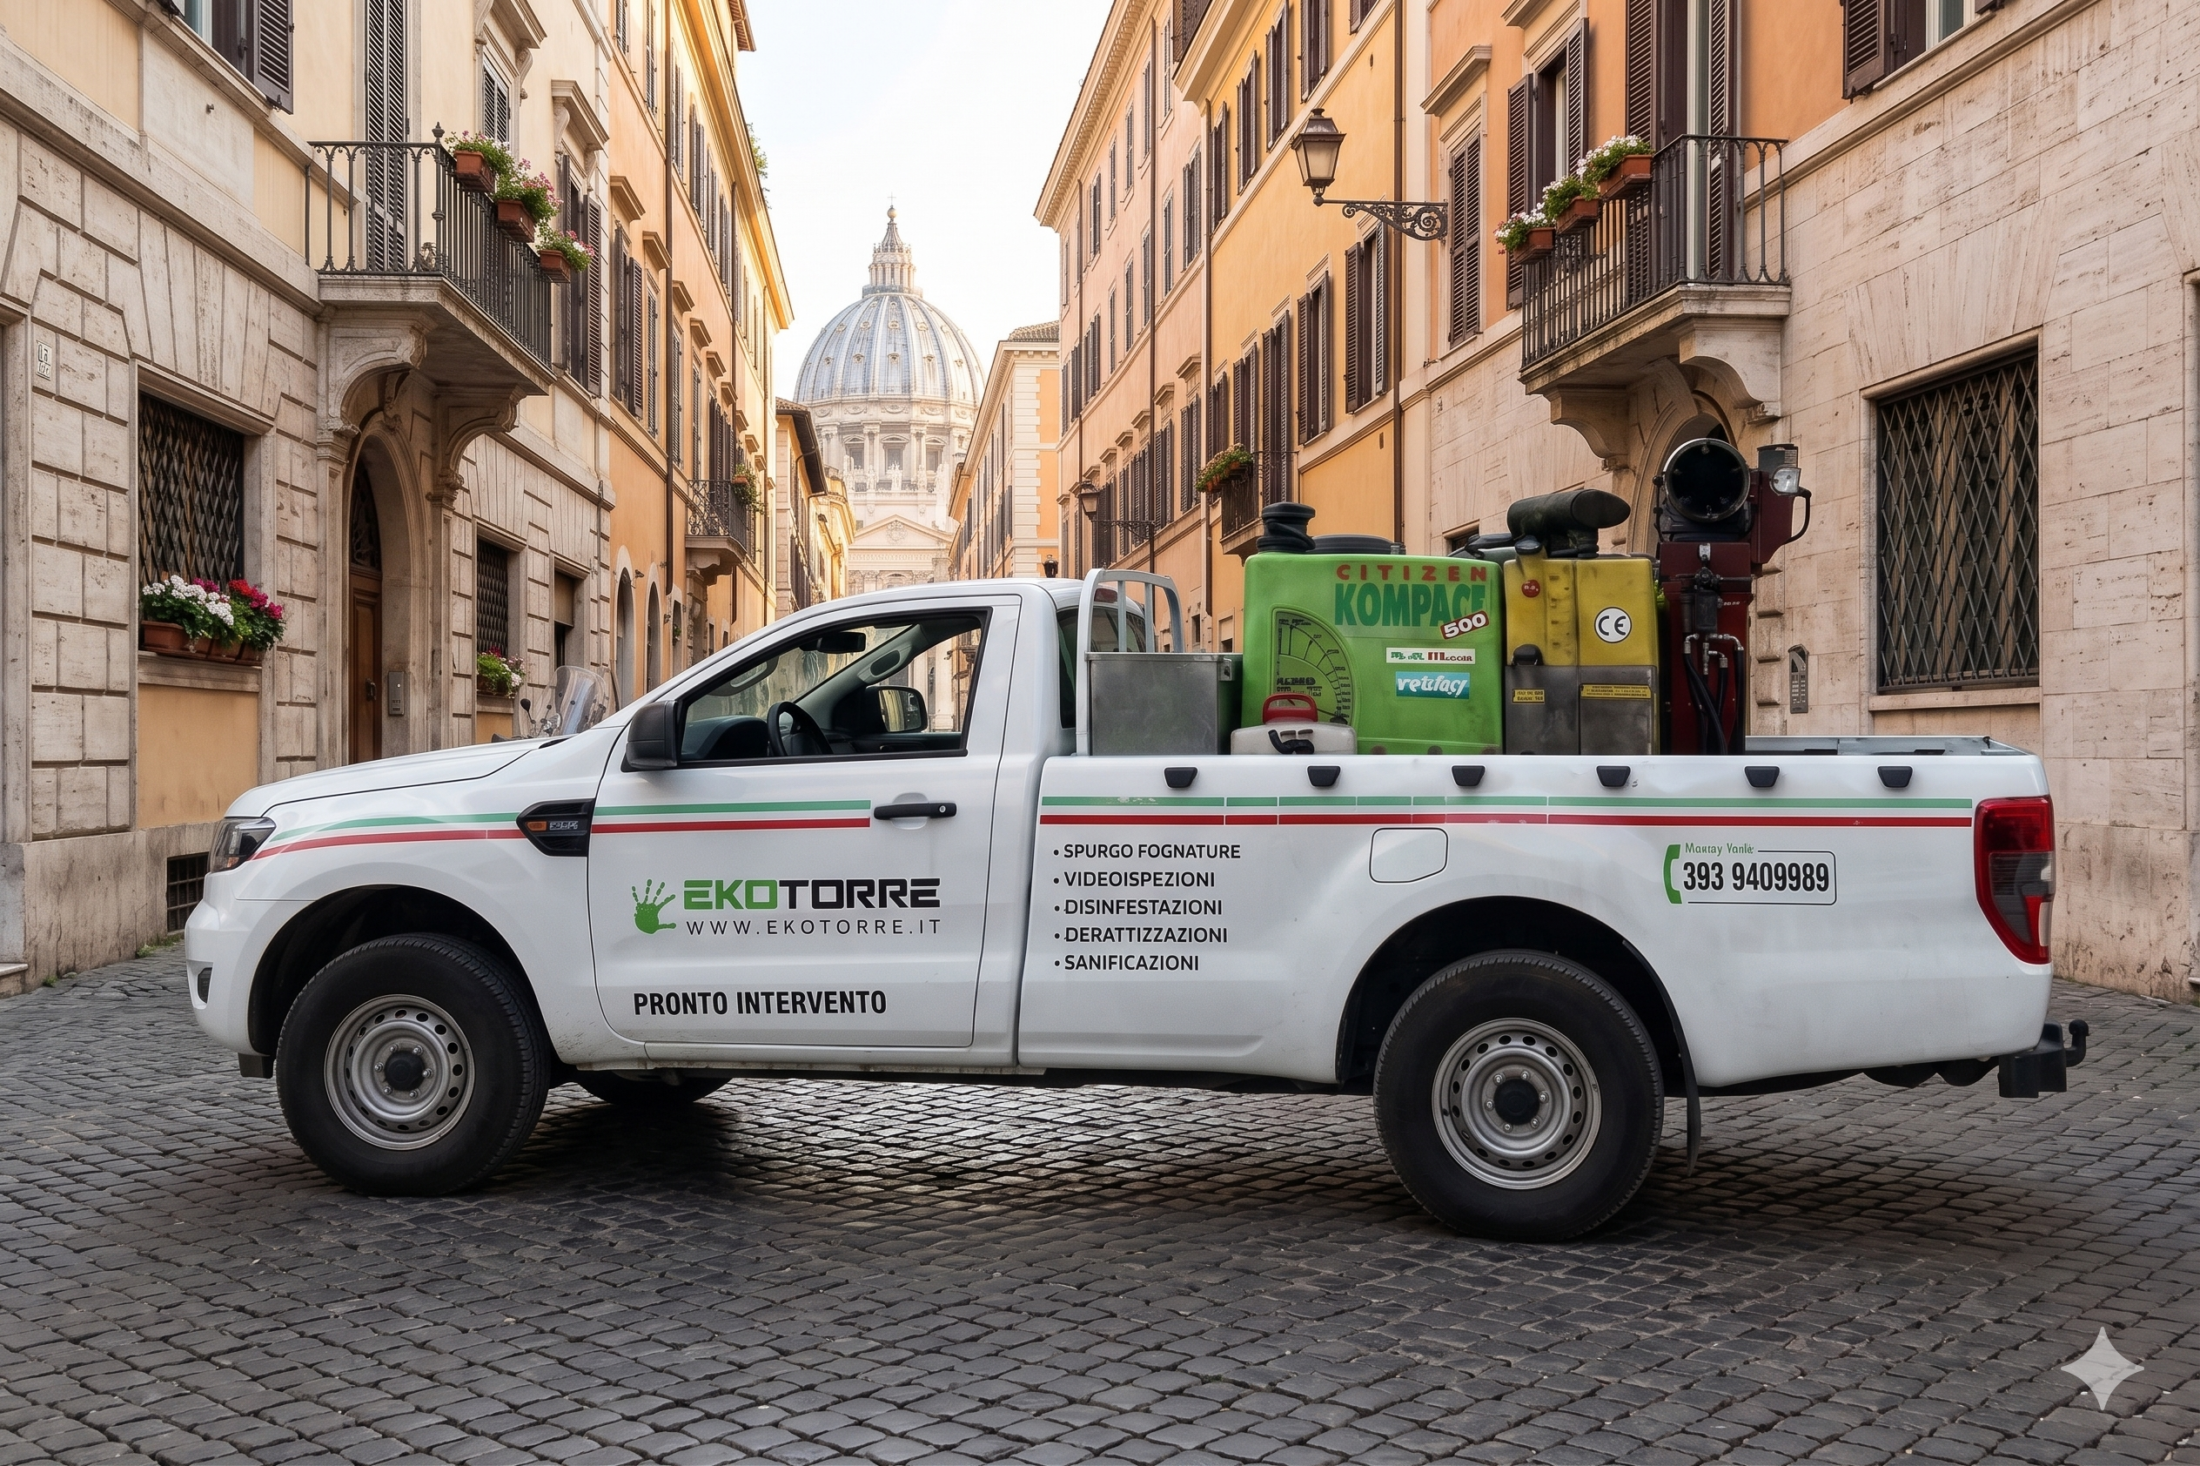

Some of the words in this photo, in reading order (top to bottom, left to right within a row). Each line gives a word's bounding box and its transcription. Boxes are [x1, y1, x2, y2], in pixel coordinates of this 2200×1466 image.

[1336, 564, 1487, 582] CITIZEN
[1443, 613, 1487, 638] 500
[1598, 615, 1627, 636] CE
[1063, 843, 1134, 859] SPURGO
[1138, 843, 1241, 859] FOGNATURE
[1063, 871, 1215, 888] VIDEOISPEZIONI
[1683, 861, 1724, 891] 393
[1731, 862, 1830, 892] 9409989
[683, 877, 941, 910] EKOTORRE
[1064, 899, 1222, 915] DISINFESTAZIONI
[686, 919, 941, 936] WWW.EKOTORRE.IT
[1064, 927, 1228, 943] DERATTIZZAZIONI
[1064, 954, 1199, 971] SANIFICAZIONI
[633, 991, 728, 1016] PRONTO
[736, 990, 887, 1015] INTERVENTO
